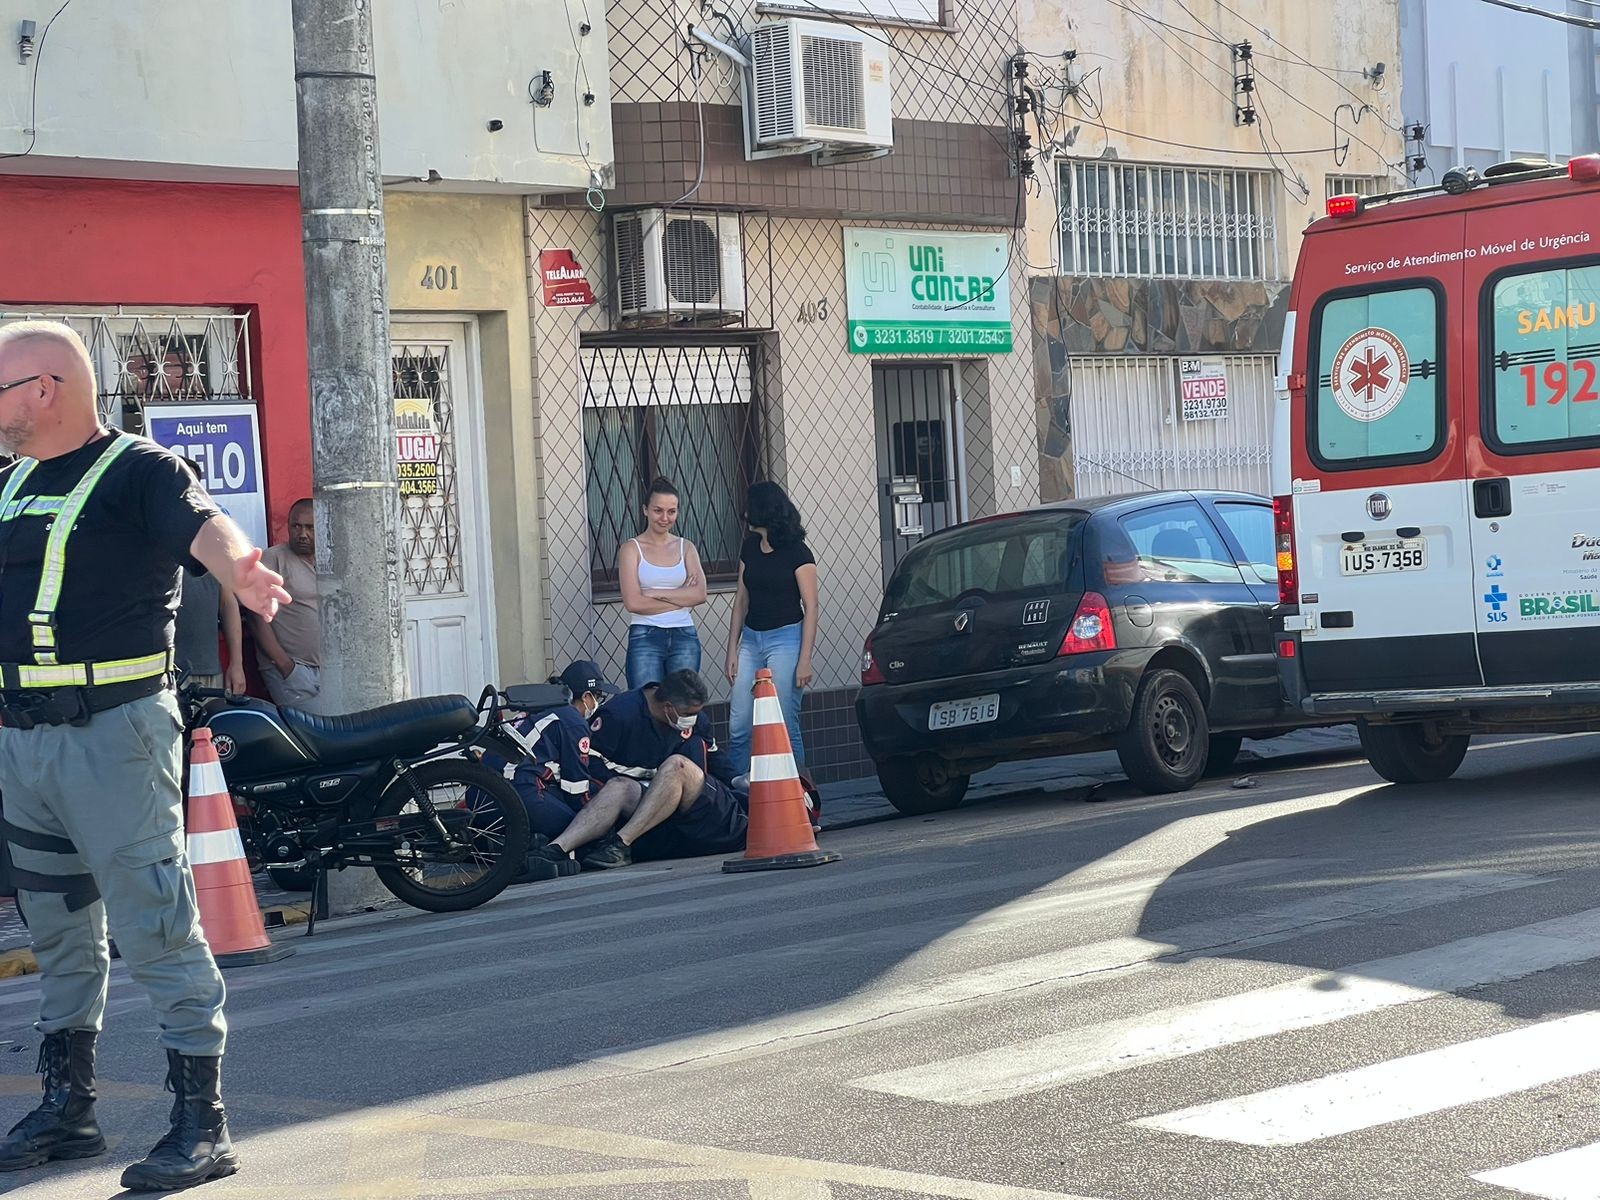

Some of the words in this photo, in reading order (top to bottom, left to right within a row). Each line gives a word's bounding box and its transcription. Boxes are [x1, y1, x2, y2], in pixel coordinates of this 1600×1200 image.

[1345, 260, 1384, 275] Serviço
[1387, 257, 1401, 269] de
[1403, 248, 1477, 267] Atendimento
[1481, 239, 1516, 256] Móvel
[1520, 238, 1535, 250] de
[1539, 231, 1590, 250] Urgência
[420, 264, 459, 291] 401
[796, 297, 828, 326] 403
[1518, 302, 1596, 335] SAMU
[874, 329, 934, 345] 3231.3519
[1183, 380, 1225, 399] VENDE
[1520, 359, 1599, 407] 192
[1183, 397, 1227, 411] 3231.9730
[1184, 408, 1227, 419] 98132.1277
[176, 421, 203, 437] Aqui
[206, 422, 228, 434] tem
[1371, 499, 1386, 513] FIAT
[1519, 593, 1600, 616] BRASIL
[1487, 611, 1508, 623] SUS
[889, 660, 905, 670] Clio
